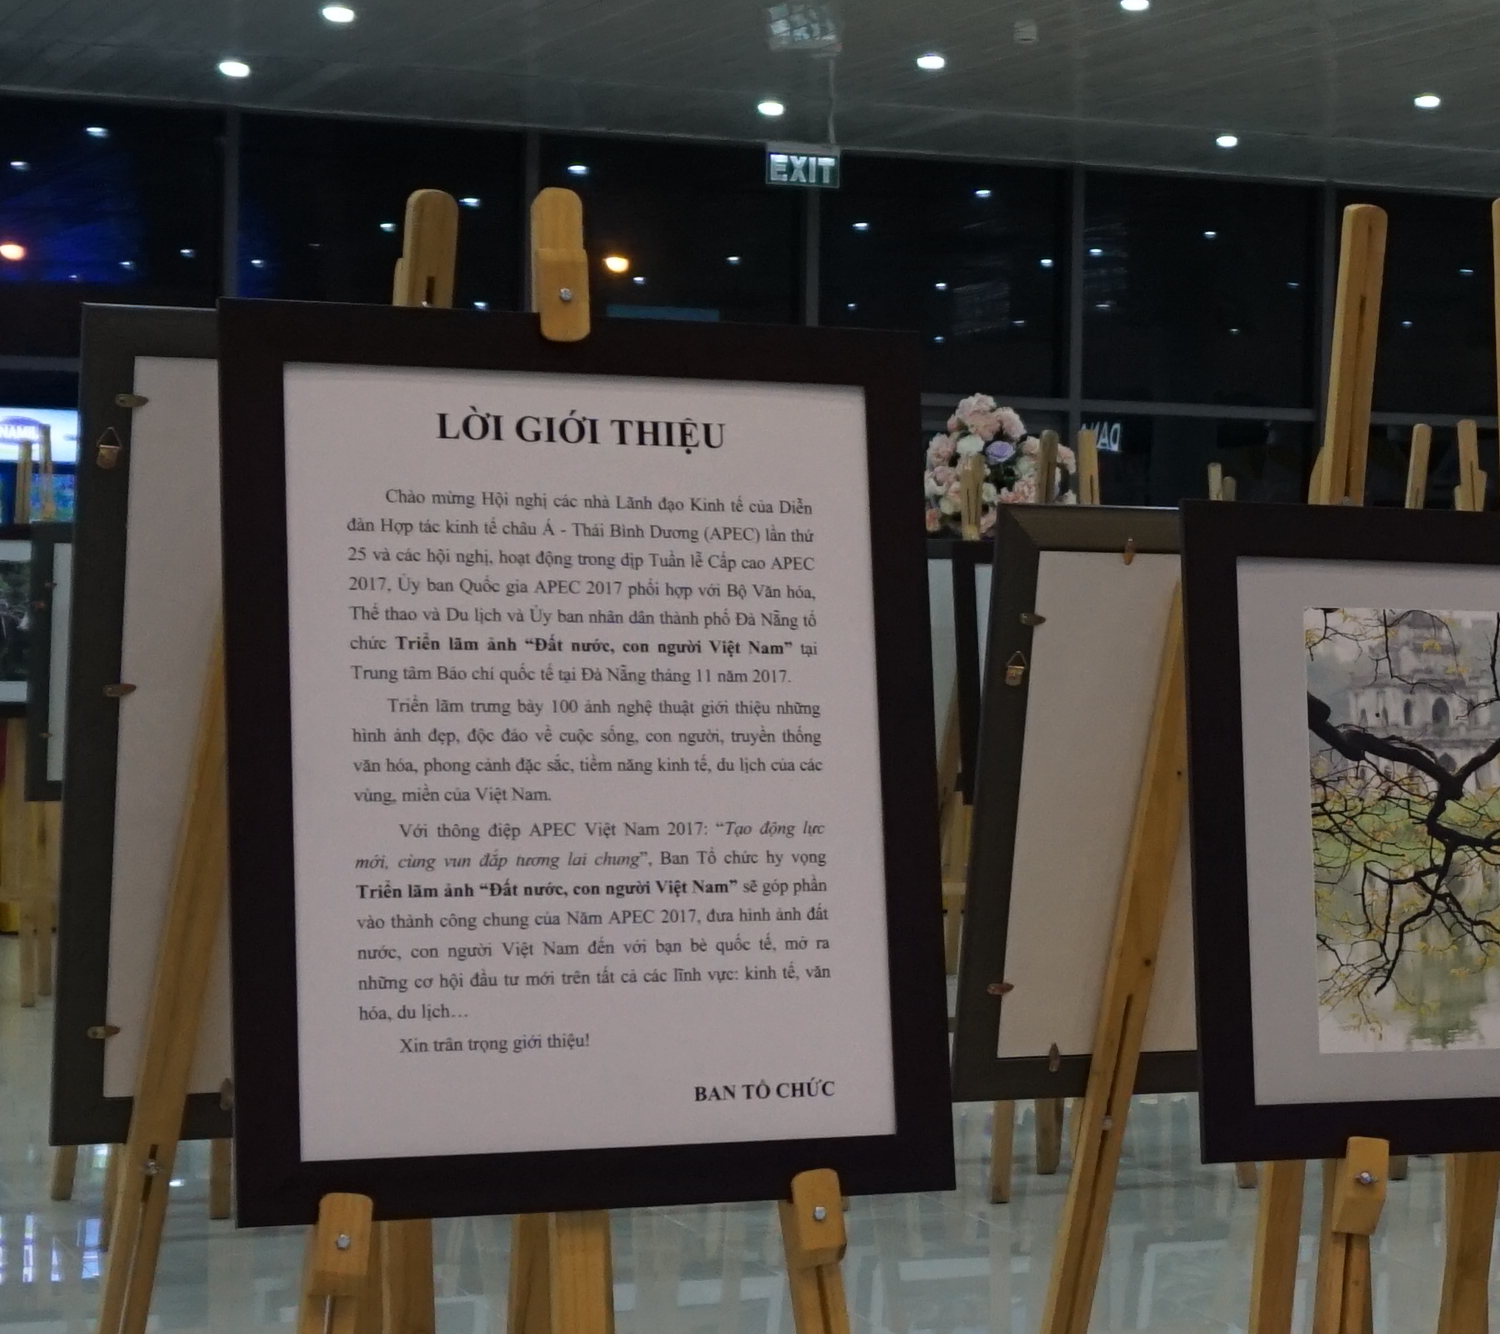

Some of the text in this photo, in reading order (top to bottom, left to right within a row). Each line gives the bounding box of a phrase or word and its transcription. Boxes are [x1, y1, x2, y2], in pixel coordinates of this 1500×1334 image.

[770, 154, 835, 183] EXIT
[436, 405, 726, 455] LỜI GIỚI THIỆU
[385, 488, 812, 514] Chào mừng Hội nghị các nhà Lãnh đạo Kinh tế của Diễn
[346, 517, 374, 532] đàn
[380, 518, 413, 536] Hợp
[418, 519, 440, 533] tác
[445, 519, 478, 534] kinh
[484, 517, 497, 534] tế
[502, 521, 536, 535] châu
[542, 518, 555, 535] Á
[571, 522, 604, 537] Thái
[609, 524, 644, 538] Bình
[650, 524, 699, 543] Dương
[703, 526, 760, 543] (APEC)
[765, 524, 786, 541] lần
[790, 528, 814, 542] thứ
[350, 635, 387, 650] chức
[394, 632, 440, 650] Triển
[449, 636, 479, 650] lãm
[487, 637, 517, 651] ảnh
[571, 638, 615, 654] nước,
[622, 642, 649, 653] con
[657, 639, 701, 657] người
[708, 640, 741, 657] Việt
[800, 641, 817, 657] tại
[387, 694, 820, 718] Triển lãm trưng bày 100 ảnh nghệ thuật giới thiệu những
[353, 783, 551, 806] vùng, miền của Việt Nam.
[399, 823, 428, 838] Với
[437, 823, 480, 841] thông
[488, 823, 521, 840] điệp
[529, 822, 576, 837] APEC
[584, 822, 616, 838] Việt
[623, 822, 660, 835] Nam
[667, 821, 707, 835] 2017:
[759, 820, 796, 838] động
[803, 820, 825, 836] lực
[355, 880, 402, 899] Triển
[407, 884, 439, 898] lãm
[443, 883, 474, 897] ảnh
[523, 881, 568, 898] nước,
[572, 885, 600, 895] con
[605, 880, 650, 898] người
[655, 879, 687, 898] Việt
[742, 879, 758, 893] sẽ
[762, 878, 788, 896] góp
[793, 874, 827, 896] phần
[358, 1006, 393, 1022] hóa,
[396, 1005, 416, 1019] du
[399, 1032, 589, 1053] Xin trân trọng giới thiệu!
[694, 1077, 835, 1102] BAN TỔ CHỨC
